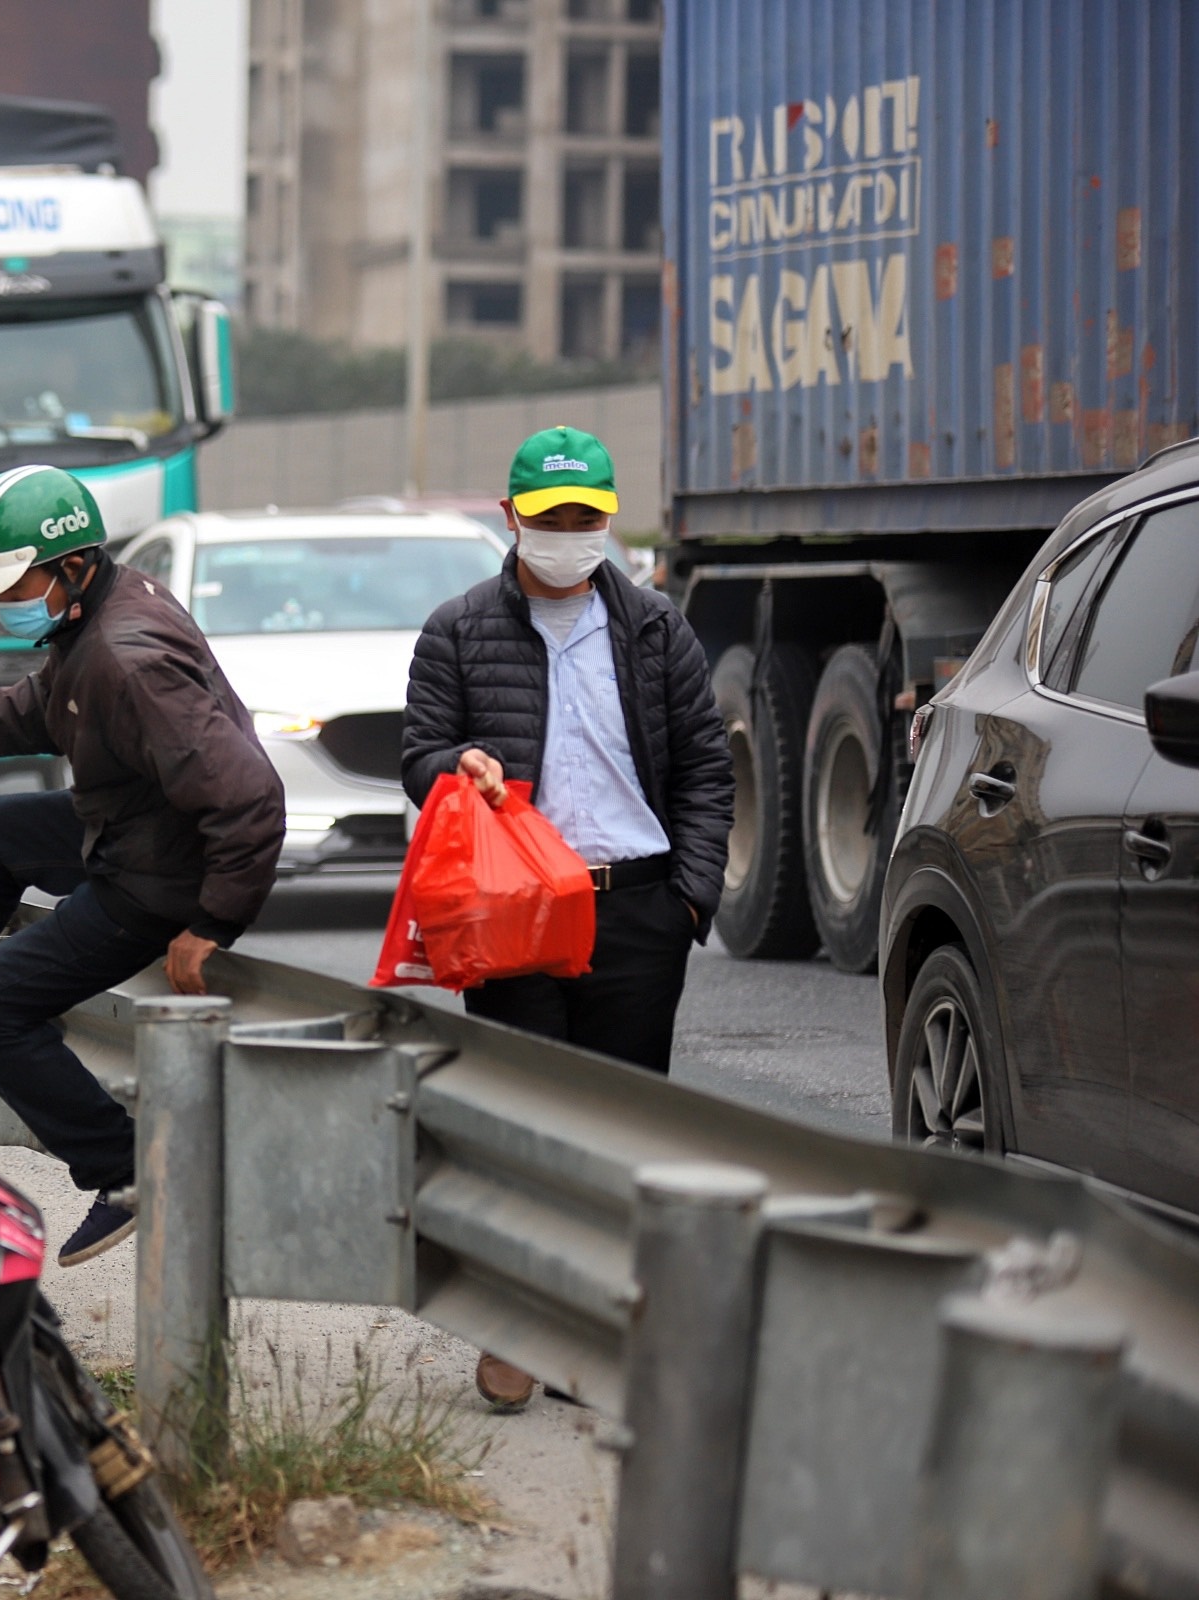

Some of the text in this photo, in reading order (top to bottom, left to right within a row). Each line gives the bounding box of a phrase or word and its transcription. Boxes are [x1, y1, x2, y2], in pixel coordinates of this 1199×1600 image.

[709, 253, 916, 396] SAGAWA
[543, 459, 589, 472] mentos
[40, 506, 90, 540] Grab
